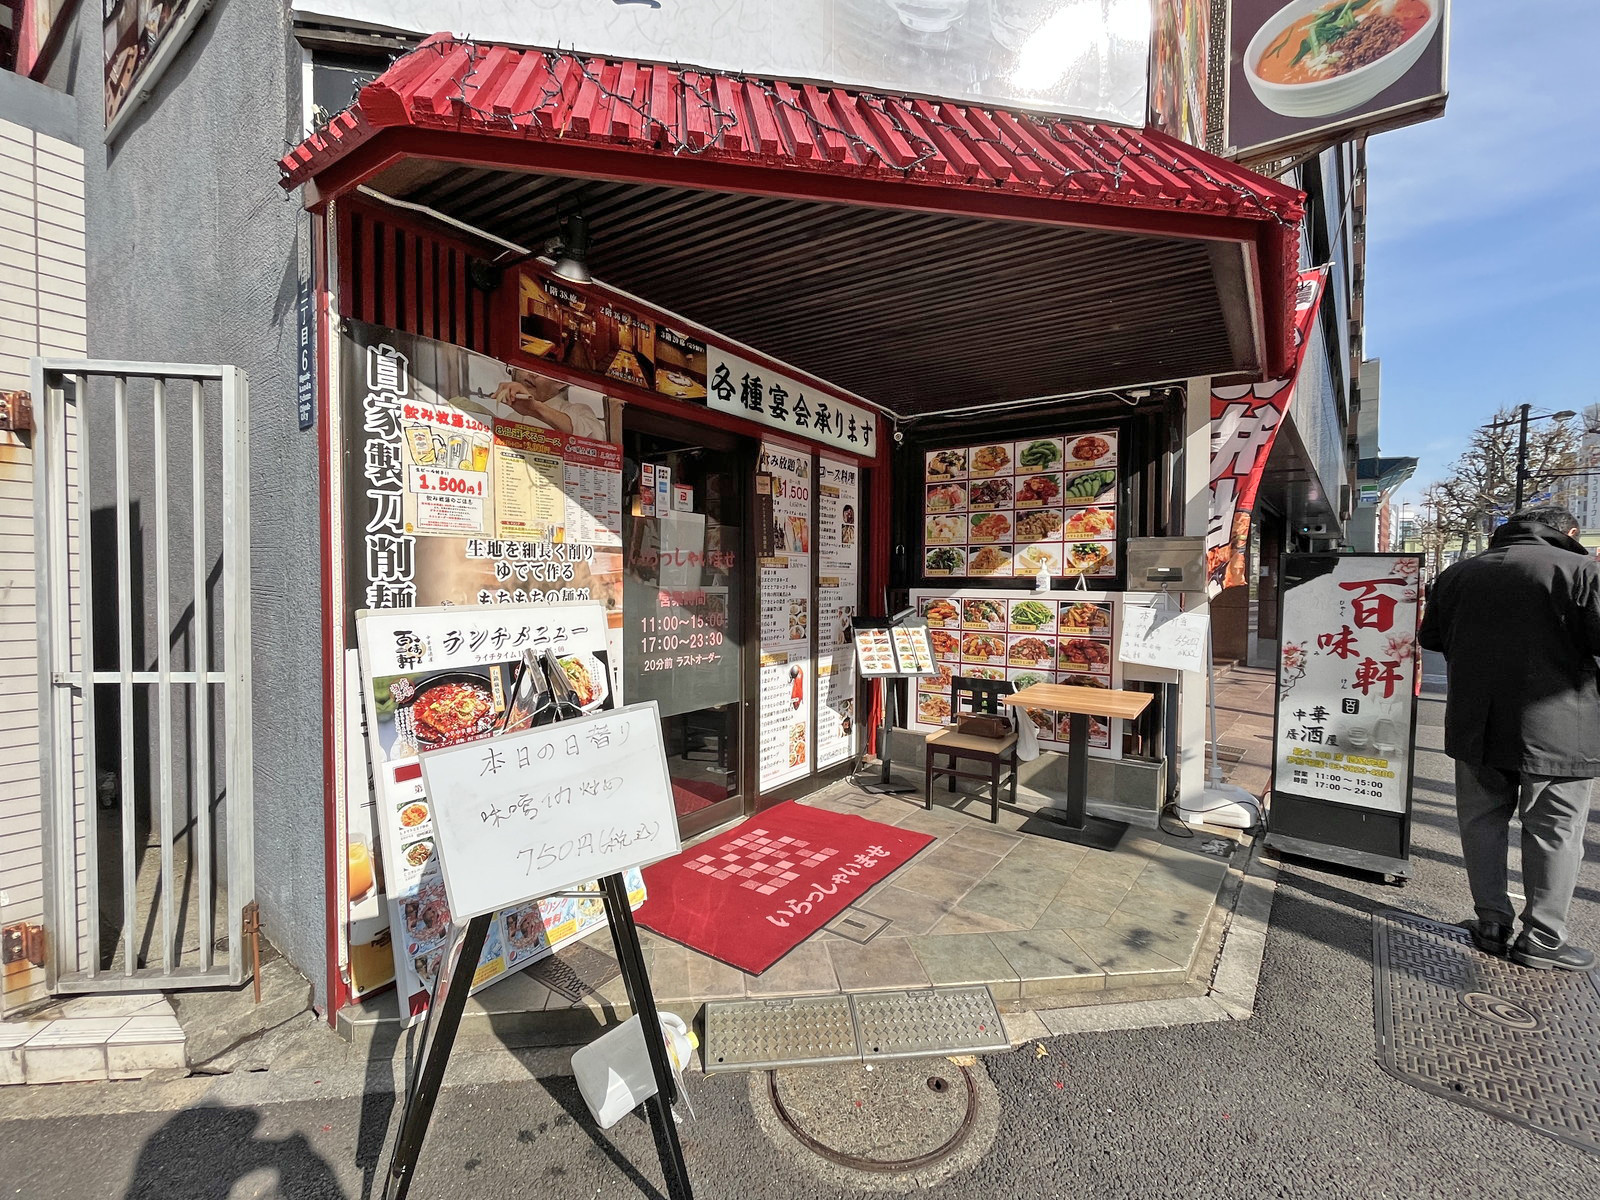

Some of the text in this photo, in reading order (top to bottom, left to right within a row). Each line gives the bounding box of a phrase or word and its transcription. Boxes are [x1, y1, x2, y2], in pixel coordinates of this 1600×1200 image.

[711, 362, 873, 448] 各種宴会承ります
[466, 539, 596, 560] 生地を細長く削り
[495, 562, 576, 584] ゆでて作る
[443, 626, 589, 657] ランチメニュー
[643, 652, 722, 672] 20分前 ラストオーダー
[1292, 705, 1331, 724] 中華
[1285, 724, 1340, 747] 居酒屋
[480, 721, 631, 777] 本日の日替り
[1315, 772, 1341, 782] 11:00
[1356, 779, 1384, 789] 15:00
[1315, 781, 1341, 791] 17:00
[1354, 788, 1383, 798] 24:00
[766, 845, 891, 927] いらっしゃいませ
